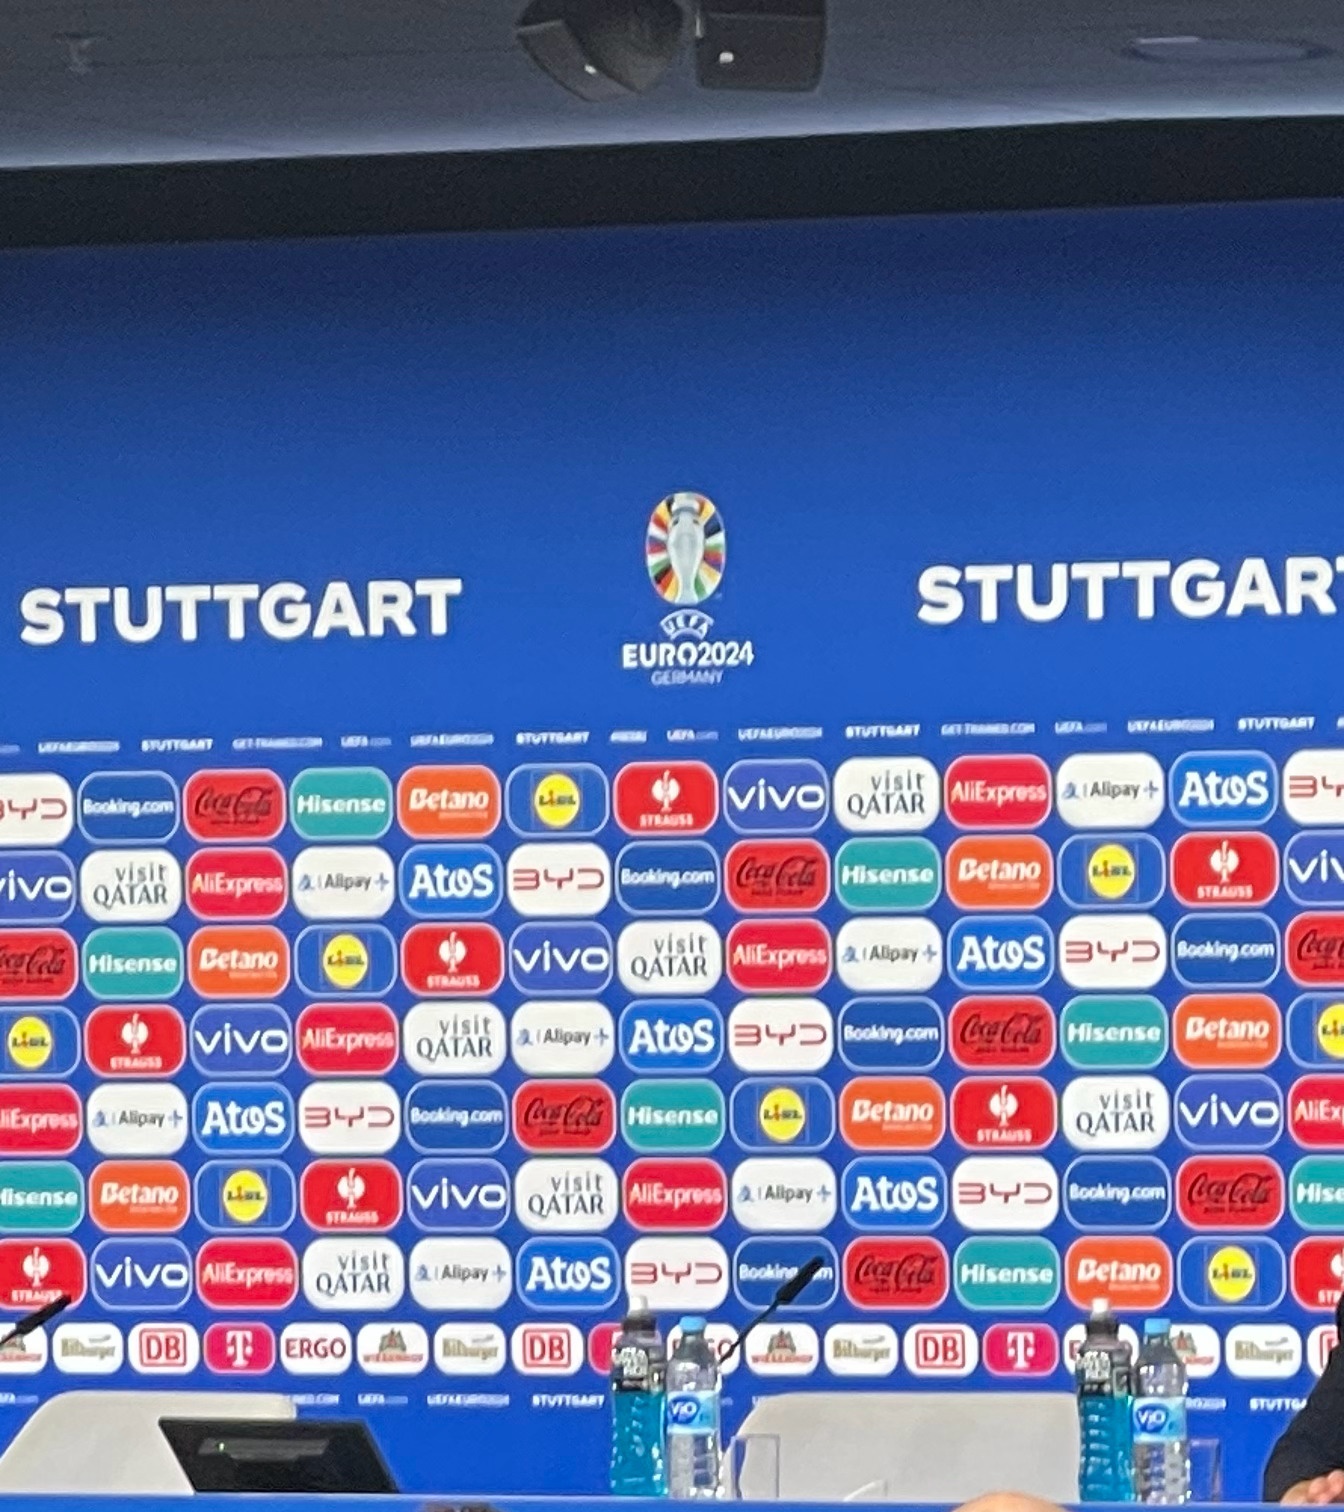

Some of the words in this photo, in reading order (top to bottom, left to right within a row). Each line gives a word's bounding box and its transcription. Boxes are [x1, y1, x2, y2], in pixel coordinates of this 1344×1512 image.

[20, 577, 462, 646] STUTTGART
[622, 640, 755, 668] EURO2024
[651, 669, 724, 686] GERMANY
[845, 722, 921, 739] STUTTGART
[1237, 716, 1316, 732] STUTTGART
[141, 738, 213, 753] STUTTGART
[516, 729, 590, 745] STUTTGART
[870, 769, 925, 791] visit
[950, 778, 1046, 808] AliExpress
[84, 796, 173, 818] Booking.com
[847, 792, 925, 818] QATAR
[621, 867, 714, 889] Booking.com
[1197, 884, 1252, 899] STRAUSS
[1064, 940, 1159, 962] BYD
[89, 953, 176, 973] Hisense
[194, 1022, 287, 1053] vivo
[1067, 1021, 1161, 1043] Hisense
[110, 1056, 161, 1069] STRAUSS
[627, 1105, 718, 1125] Hisense
[851, 1098, 934, 1122] Betano
[1178, 1093, 1279, 1125] vivo
[977, 1128, 1031, 1142] STRAUSS
[550, 1170, 603, 1191] visit
[100, 1181, 178, 1204] Betano
[628, 1182, 722, 1209] AliExpress
[1069, 1183, 1165, 1204] Booking.com
[528, 1193, 603, 1217] QATAR
[202, 1261, 292, 1288] AliExpress
[630, 1262, 722, 1283] BYD
[1077, 1257, 1161, 1281] Betano
[147, 1335, 181, 1360] DB
[285, 1338, 346, 1359] ERGO
[529, 1336, 565, 1361] DB
[922, 1335, 960, 1363] DB
